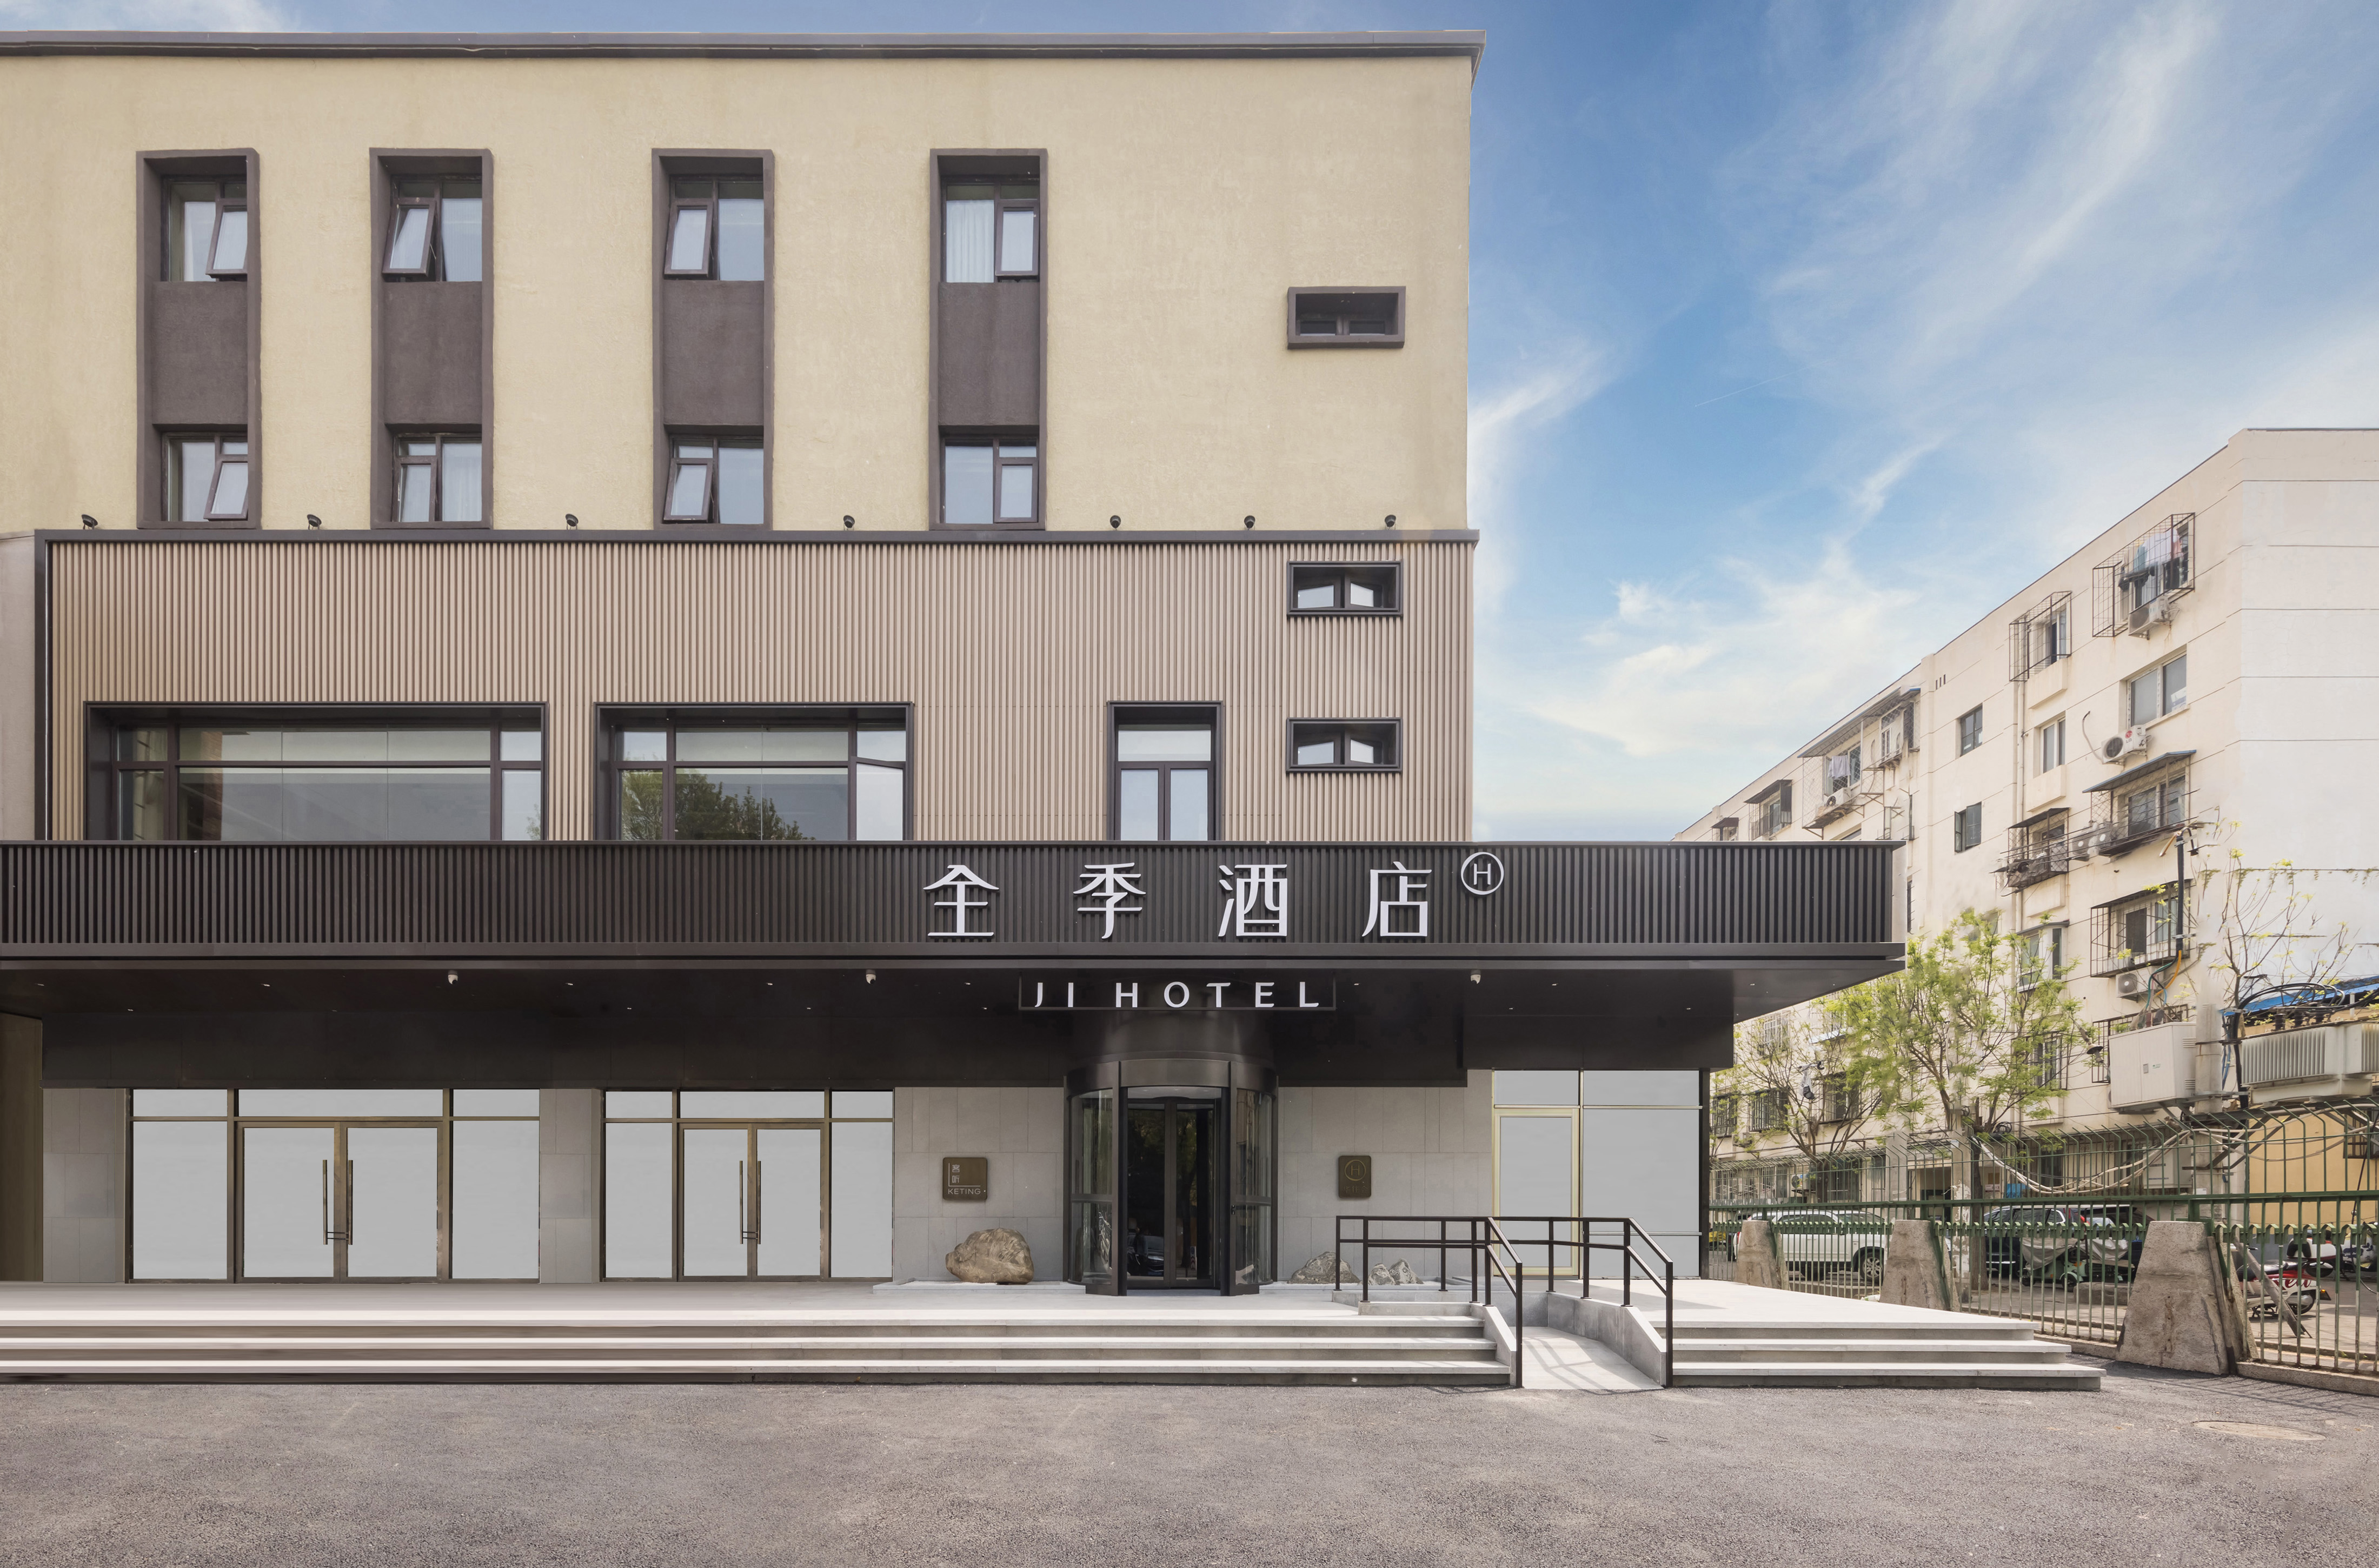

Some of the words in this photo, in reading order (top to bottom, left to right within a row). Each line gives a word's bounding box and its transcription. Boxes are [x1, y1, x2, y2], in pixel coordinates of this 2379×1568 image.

[923, 862, 1432, 939] 全季酒店
[1034, 982, 1074, 1008] JI
[1115, 981, 1320, 1008] HOTEL
